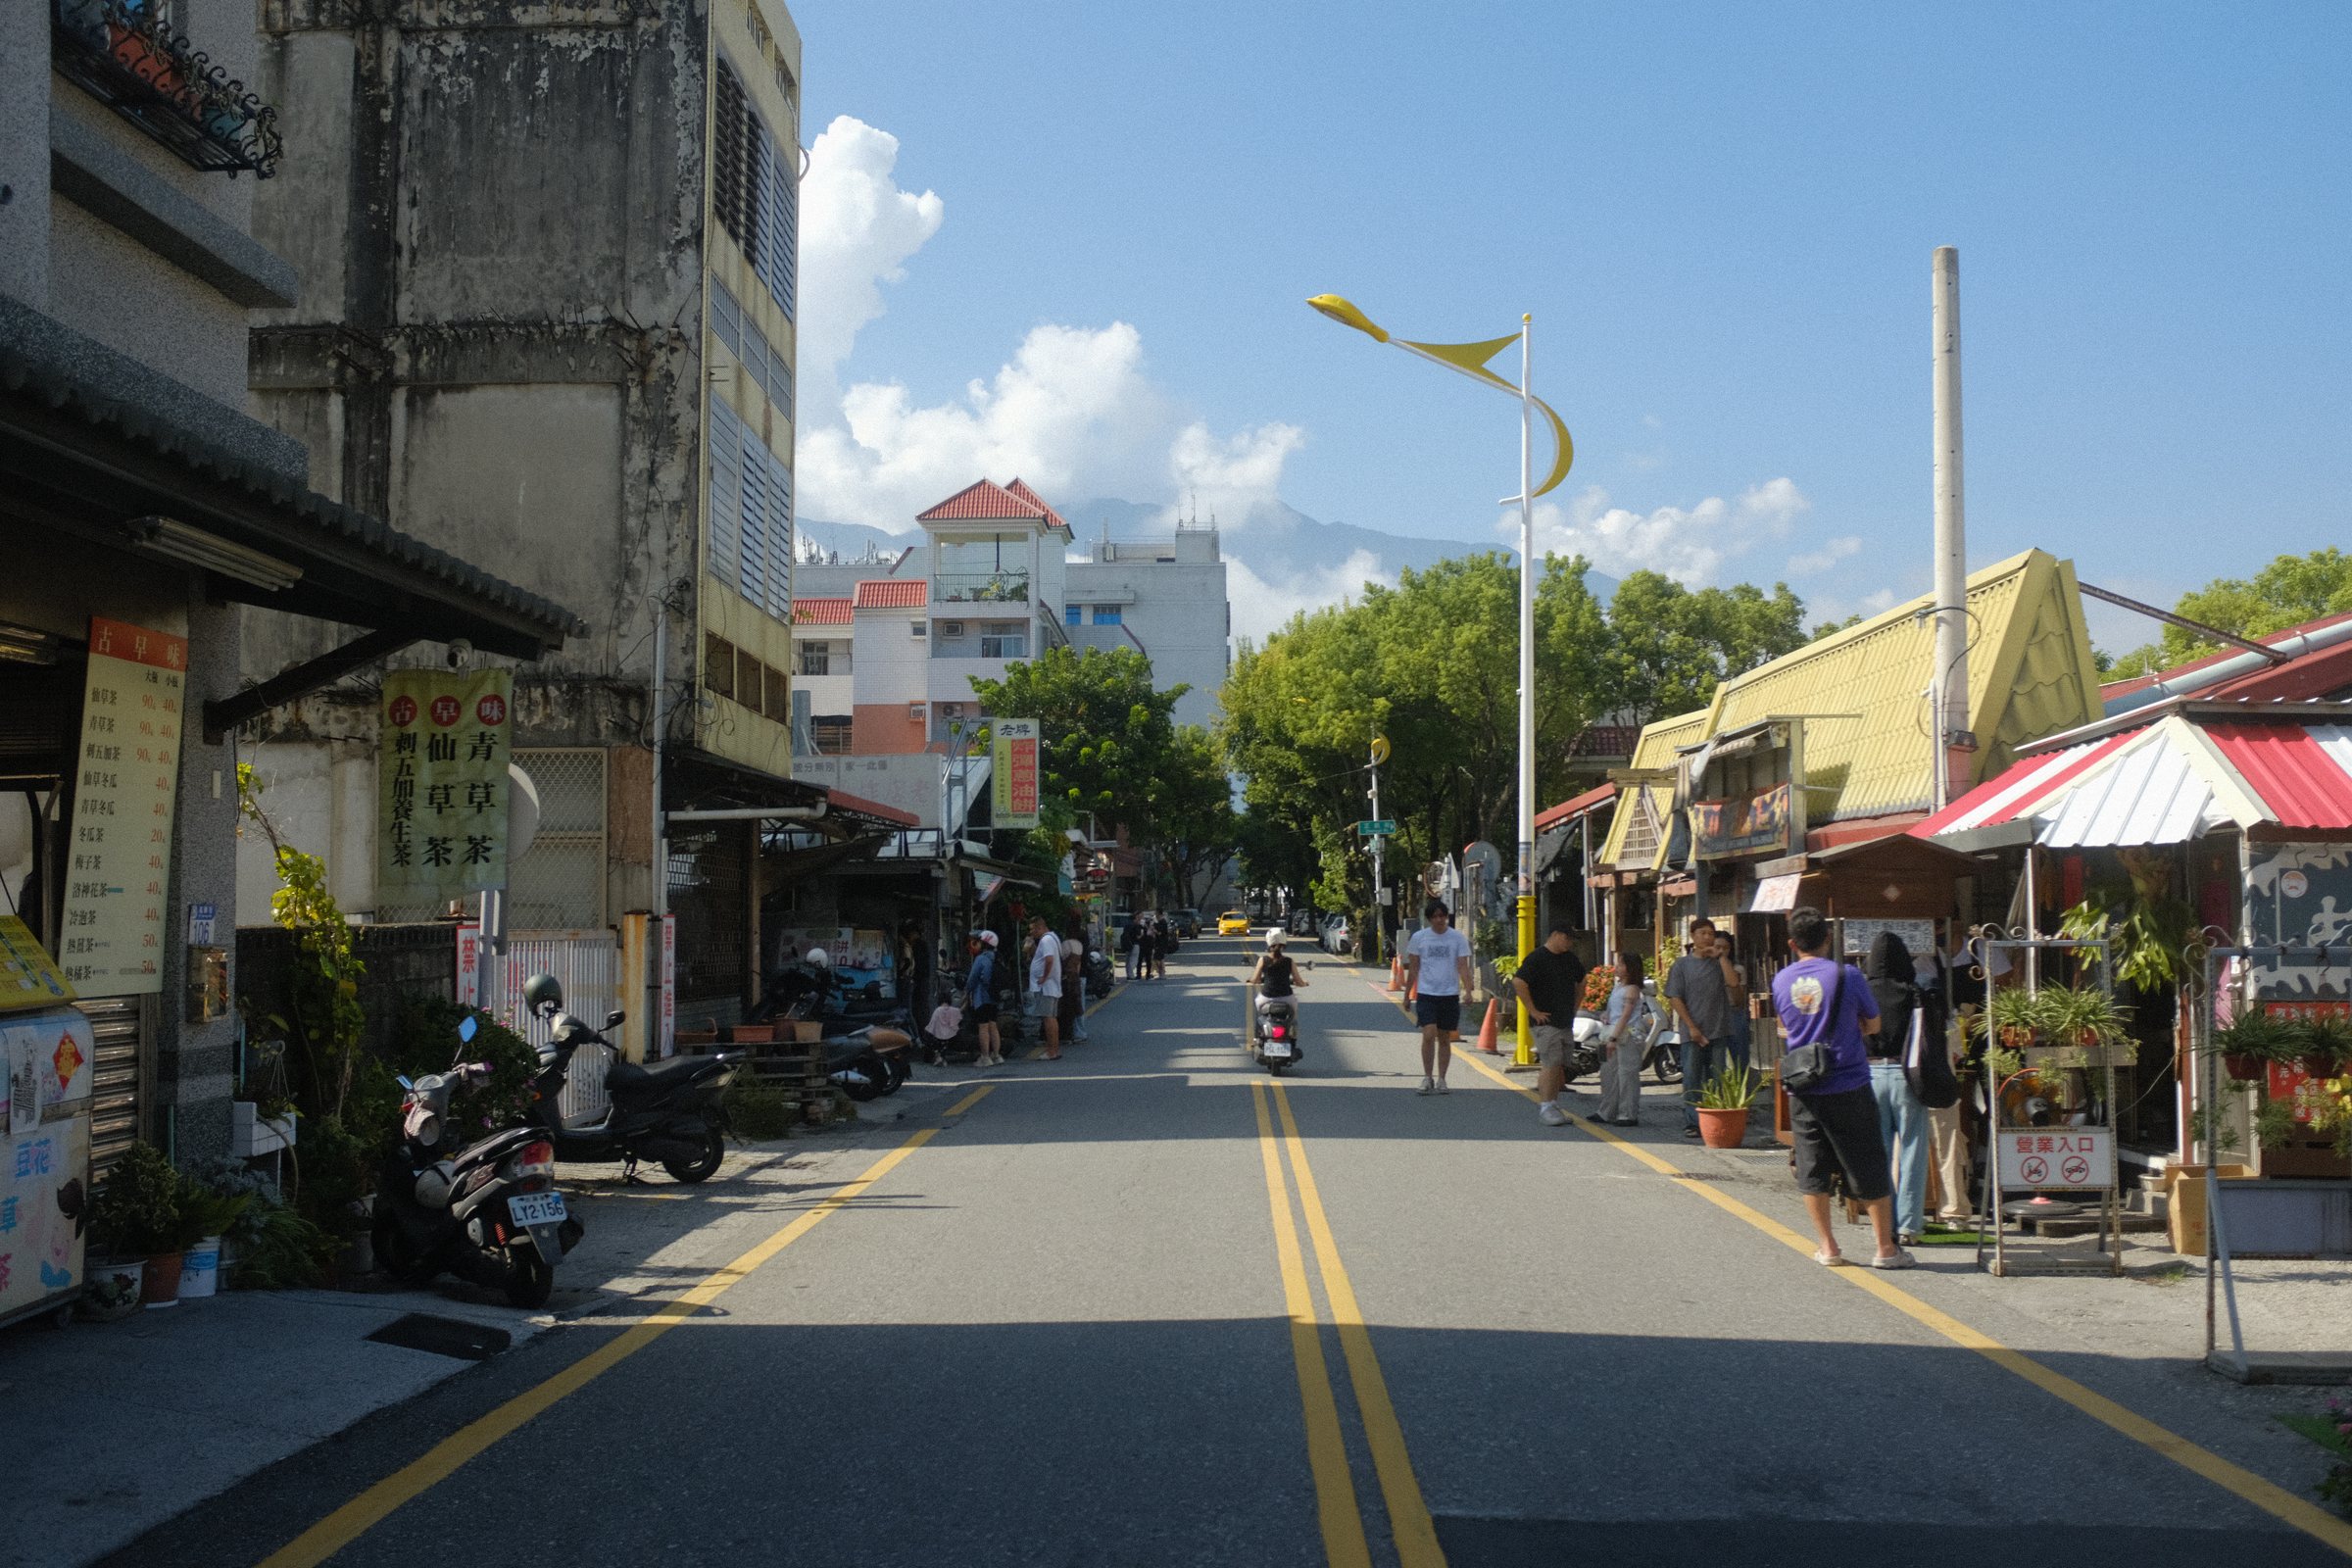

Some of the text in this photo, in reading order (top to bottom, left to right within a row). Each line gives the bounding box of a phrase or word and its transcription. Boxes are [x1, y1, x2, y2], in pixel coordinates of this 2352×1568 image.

[97, 625, 180, 668] 古早味
[91, 687, 118, 706] 仙草茶
[394, 701, 503, 723] 古早味
[89, 714, 115, 733] 青草茶
[1000, 724, 1031, 736] 老牌
[390, 732, 417, 867] 刺五加養生茶
[422, 733, 457, 867] 仙草茶
[463, 731, 498, 864] 青草茶
[79, 826, 104, 843] 冬瓜茶
[193, 921, 210, 945] 106
[2016, 1135, 2094, 1154] 營業入口
[512, 1201, 564, 1222] LY2-156
